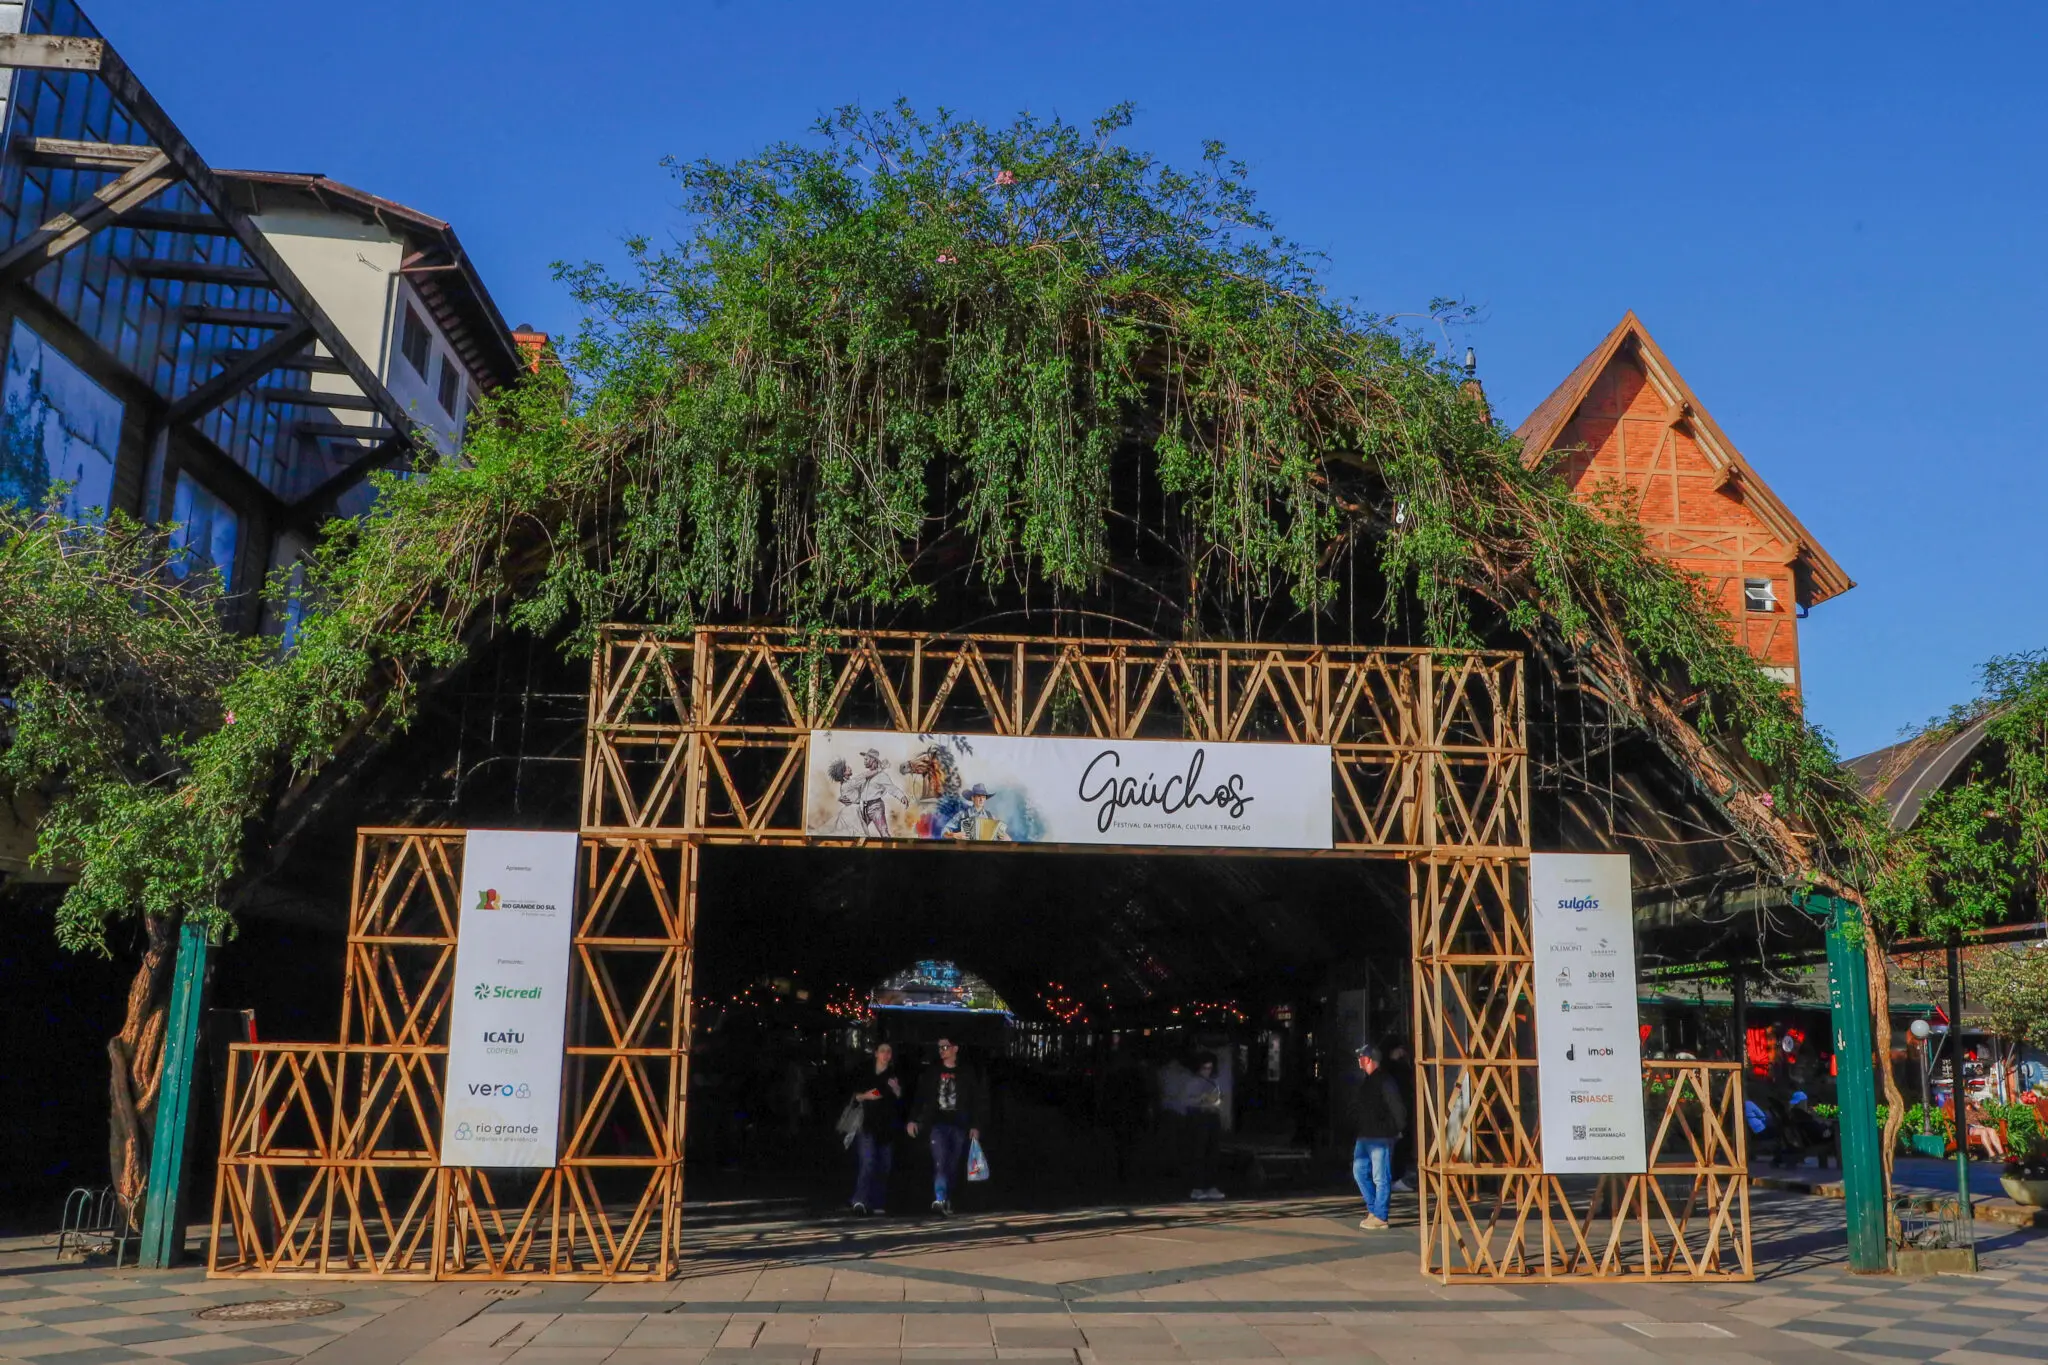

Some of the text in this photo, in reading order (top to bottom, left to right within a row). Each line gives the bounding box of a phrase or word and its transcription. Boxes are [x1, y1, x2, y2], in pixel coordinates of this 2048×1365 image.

[1220, 823, 1251, 832] TRADIÇÃO
[1557, 895, 1600, 912] sulgás
[492, 985, 542, 999] Sicredi
[483, 1030, 525, 1044] ICATU
[468, 1083, 514, 1097] vero
[476, 1122, 539, 1136] rio grande
